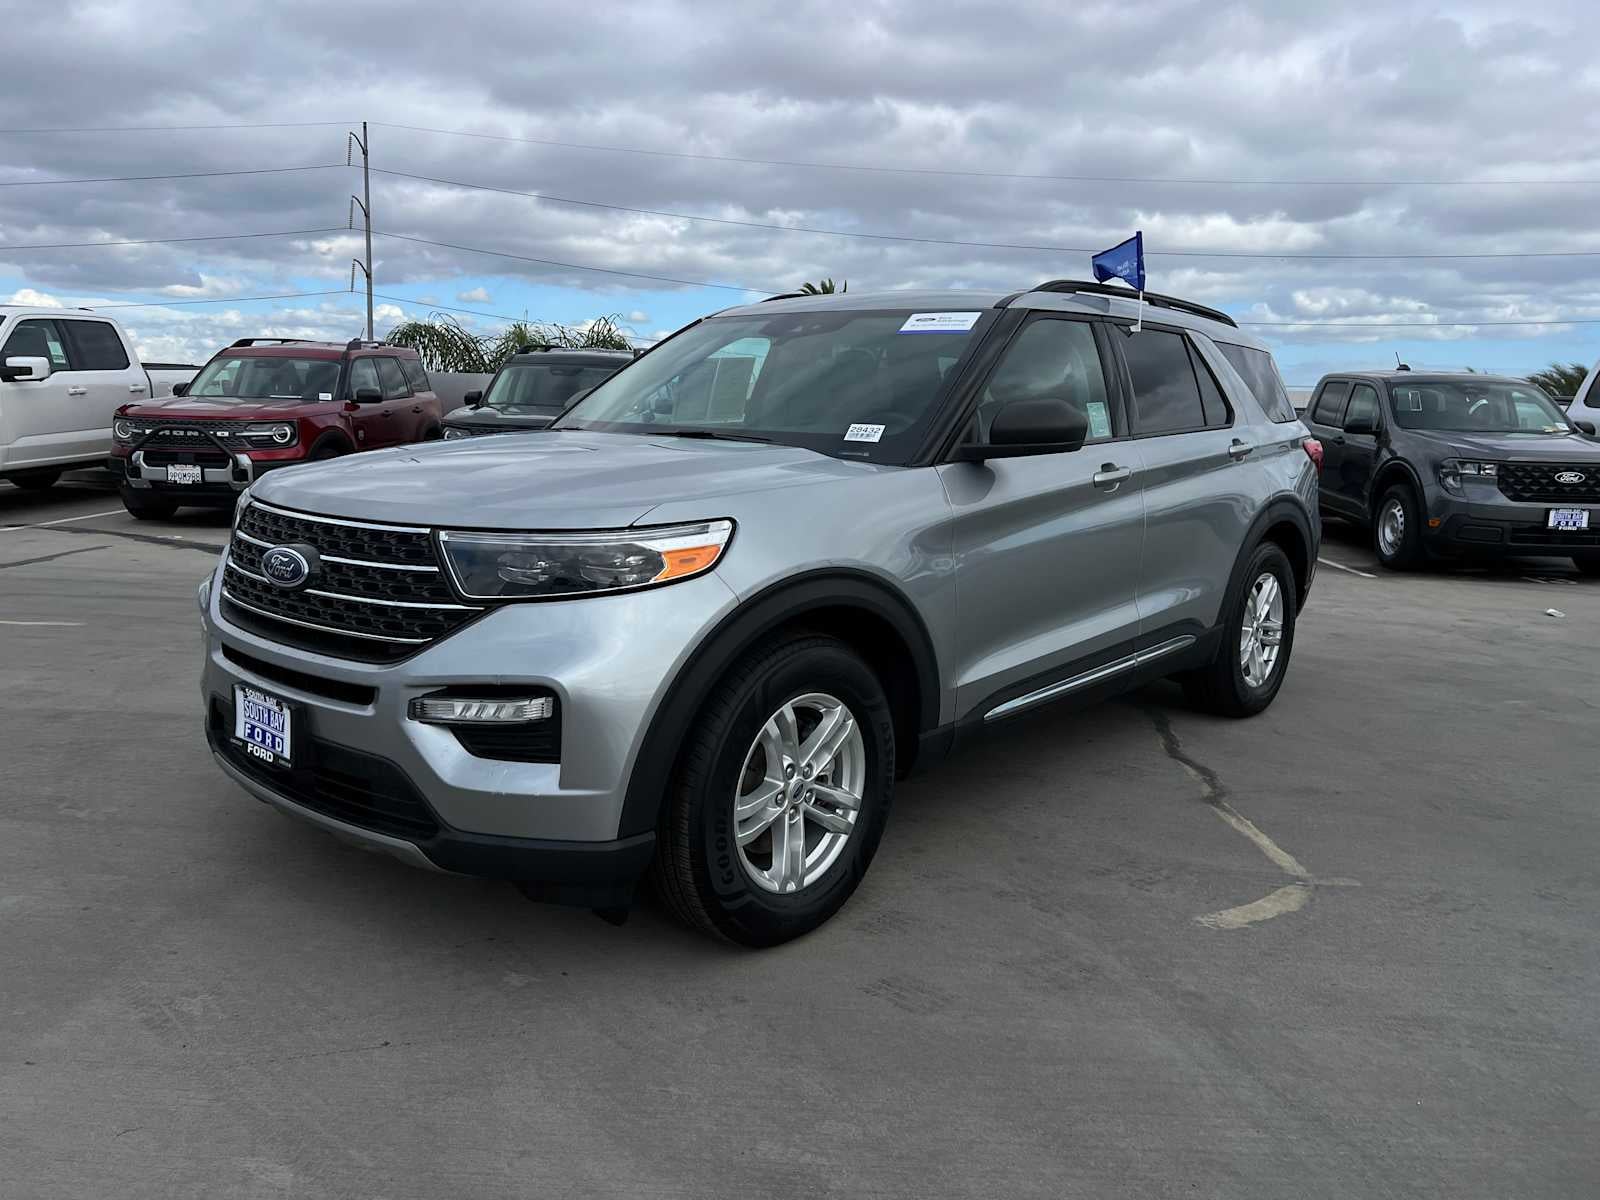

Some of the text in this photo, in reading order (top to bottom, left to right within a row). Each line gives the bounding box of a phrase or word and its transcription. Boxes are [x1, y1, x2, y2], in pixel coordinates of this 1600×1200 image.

[244, 700, 284, 733] SOUTH BAY
[245, 723, 283, 752] FORD
[247, 742, 274, 763] FORD
